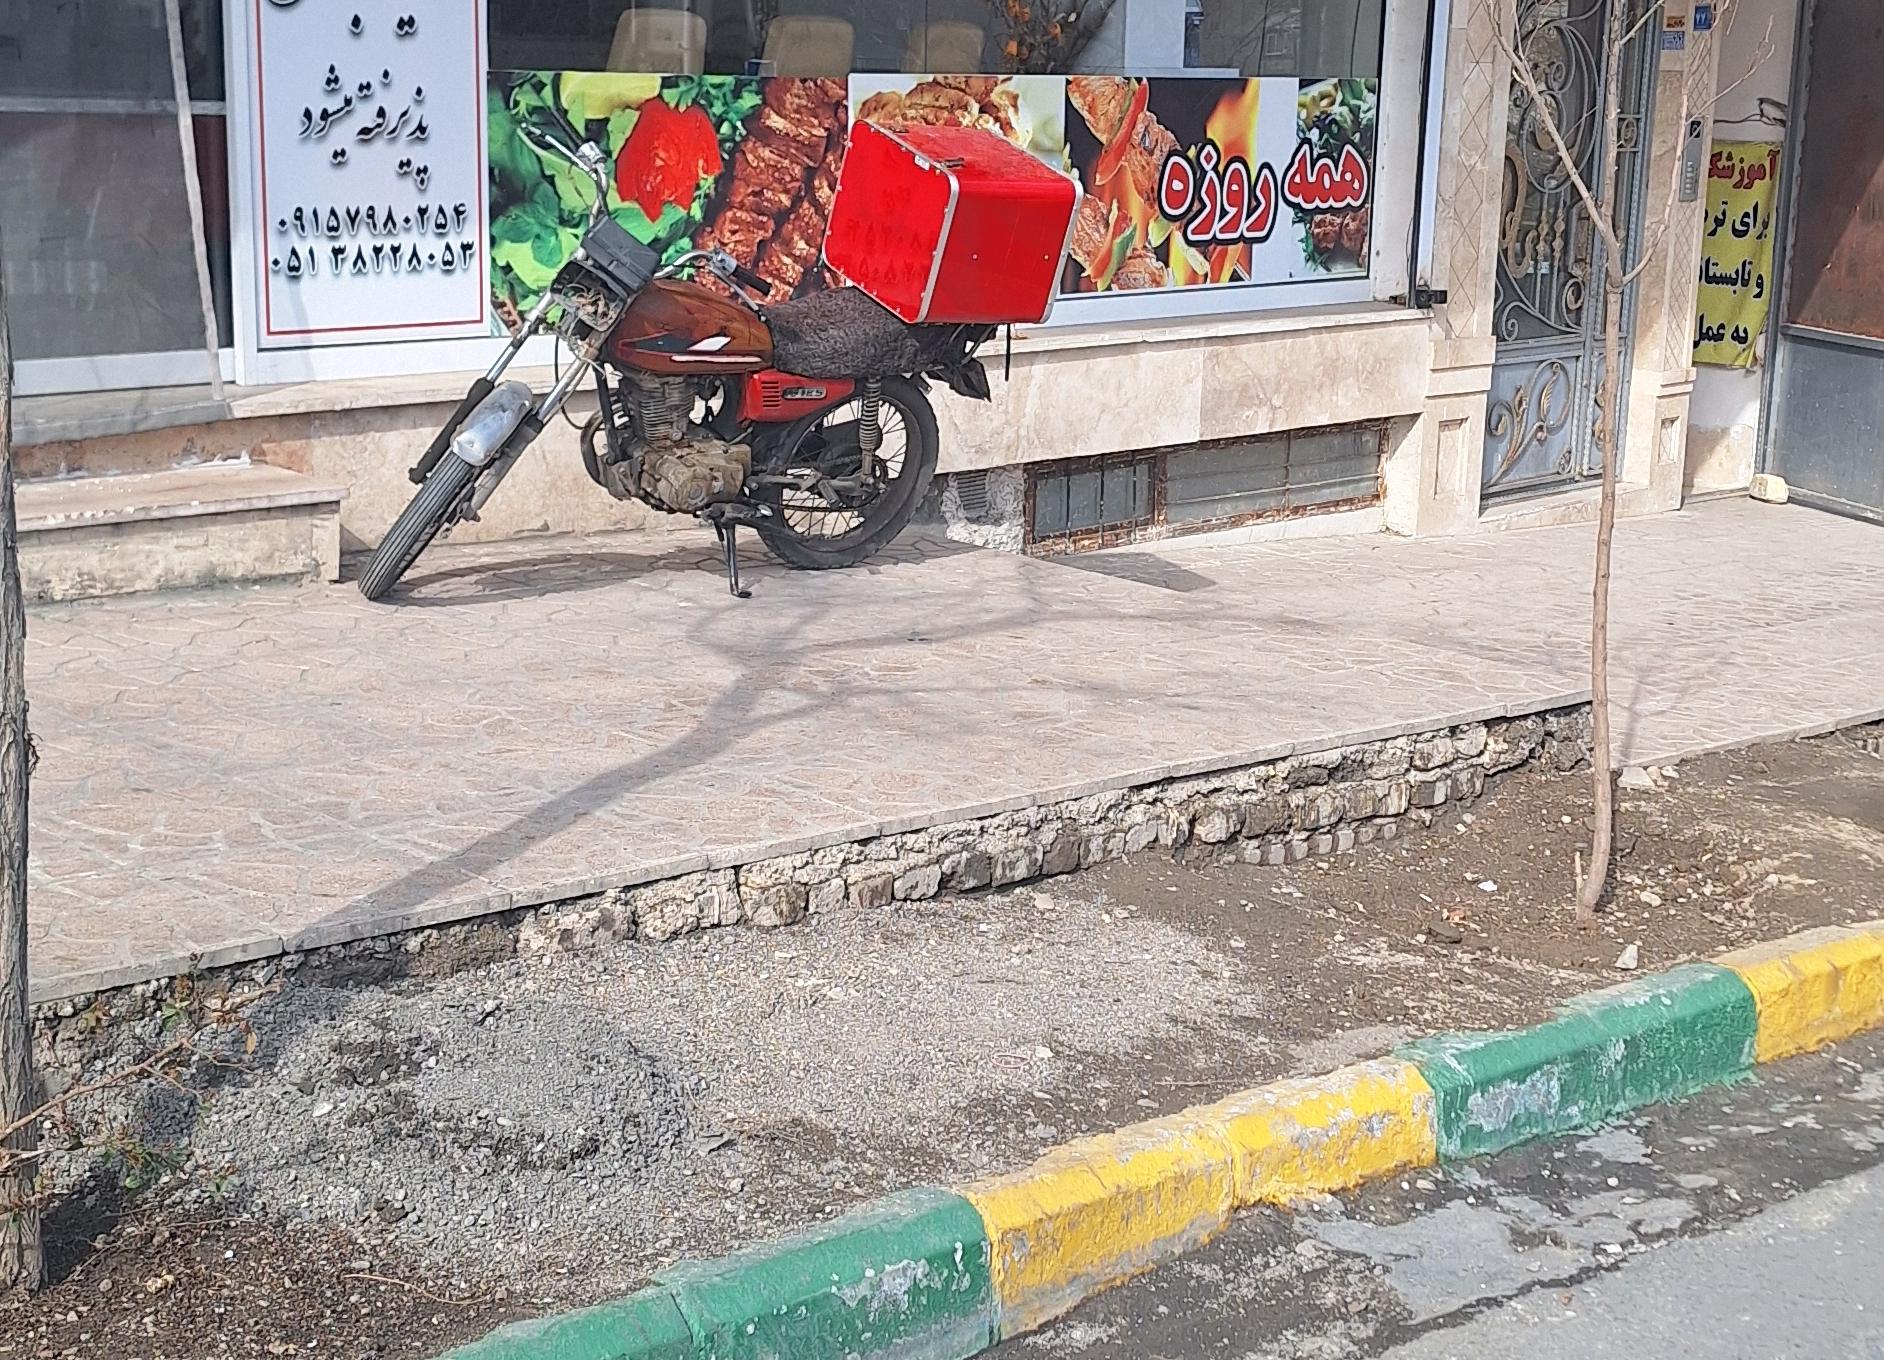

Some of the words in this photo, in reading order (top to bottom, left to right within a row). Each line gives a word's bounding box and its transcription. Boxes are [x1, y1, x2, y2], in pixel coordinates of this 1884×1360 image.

[355, 68, 430, 189] پذیرفته
[1159, 142, 1277, 241] روزه
[1284, 142, 1369, 210] همه
[278, 202, 469, 237] ۰۹۱۵۷۹۸۰۲۵۴
[1732, 200, 1771, 240] برای
[271, 244, 319, 277] ۰۵۱
[330, 239, 475, 275] ۳۸۲۲۸۰۵۳
[1752, 272, 1764, 299] و
[1693, 312, 1726, 349] عمل
[1730, 324, 1749, 352] به
